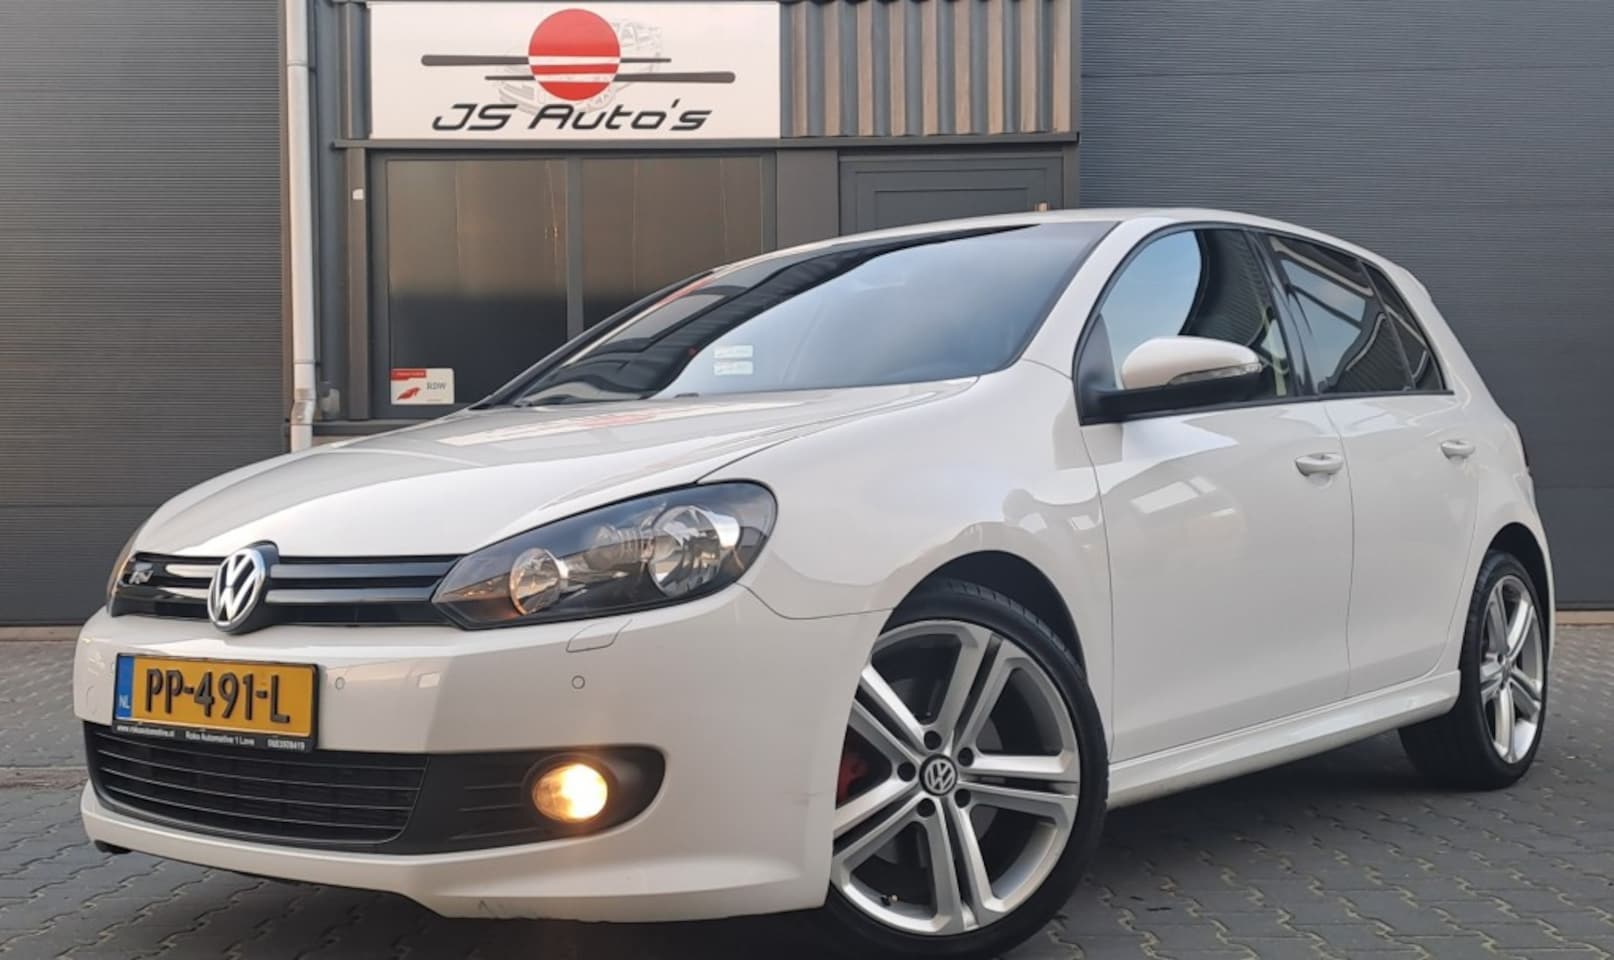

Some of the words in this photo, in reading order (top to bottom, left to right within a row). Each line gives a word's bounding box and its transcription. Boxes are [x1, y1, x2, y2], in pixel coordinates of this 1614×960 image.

[432, 104, 518, 131] JS
[527, 99, 712, 131] Auto's
[118, 694, 131, 709] NL
[145, 669, 290, 722] PP-491-L
